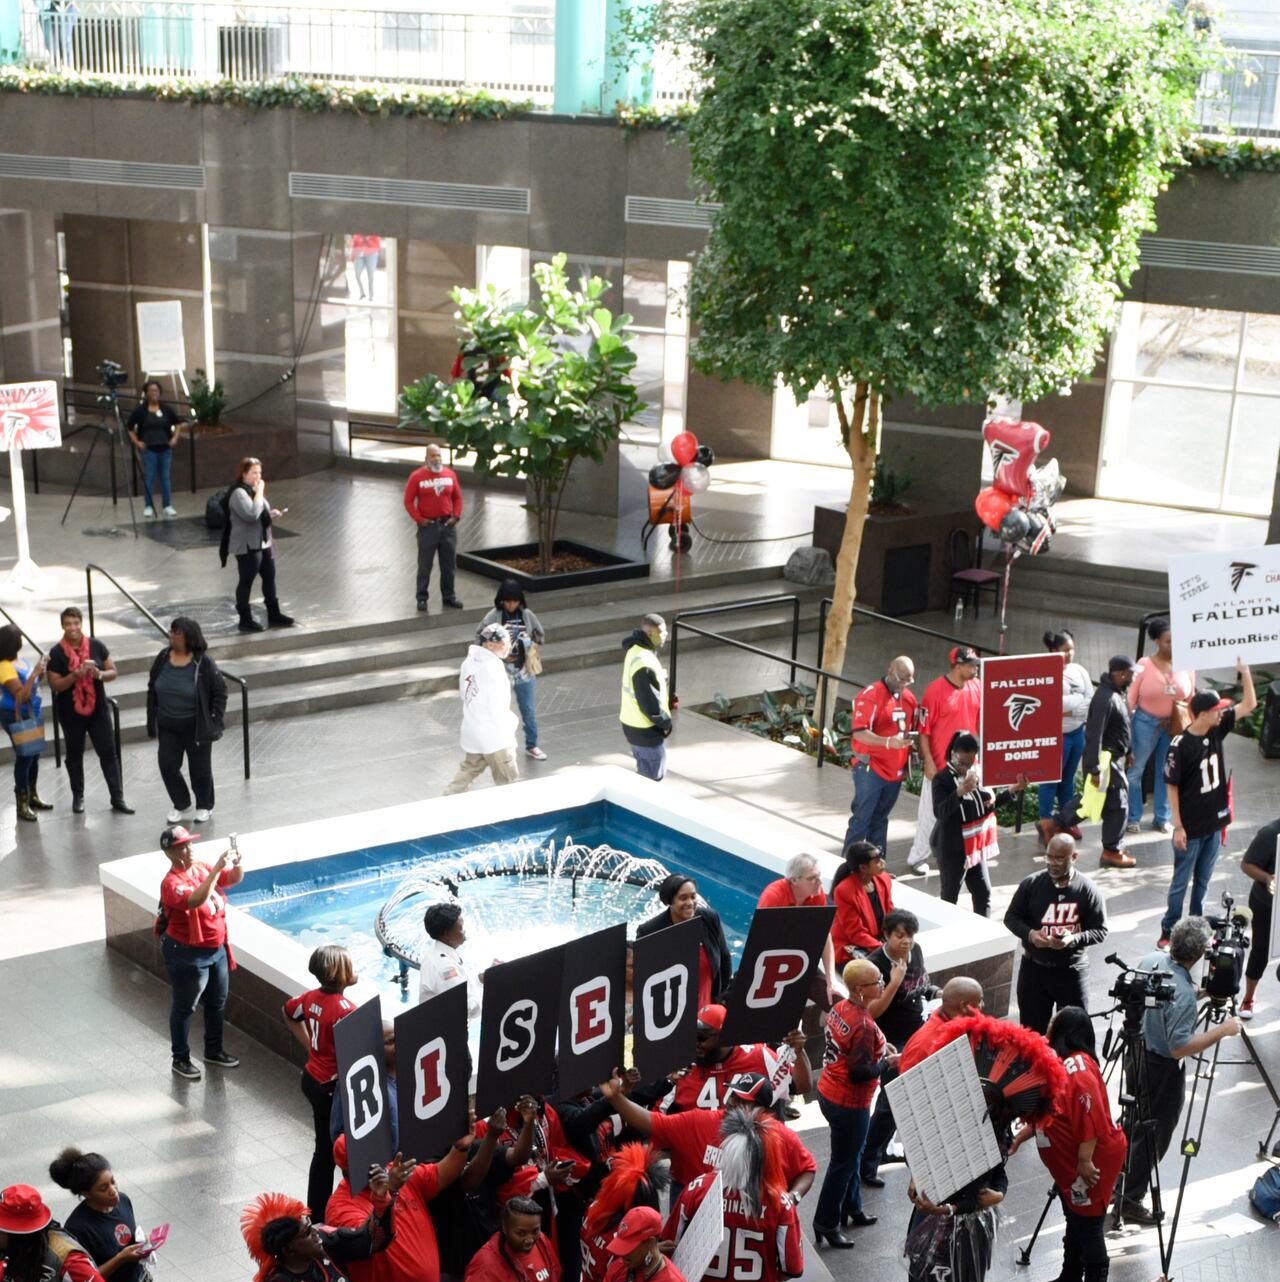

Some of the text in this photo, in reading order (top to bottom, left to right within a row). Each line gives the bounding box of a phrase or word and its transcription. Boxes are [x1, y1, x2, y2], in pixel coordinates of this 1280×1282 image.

[1180, 581, 1210, 601] TIME
[990, 676, 1055, 690] FALCONS
[986, 737, 1058, 752] DEFEND THE
[1004, 750, 1040, 762] DOME
[1200, 753, 1221, 794] 11
[1041, 903, 1080, 925] ATL
[1063, 1054, 1087, 1075] 21
